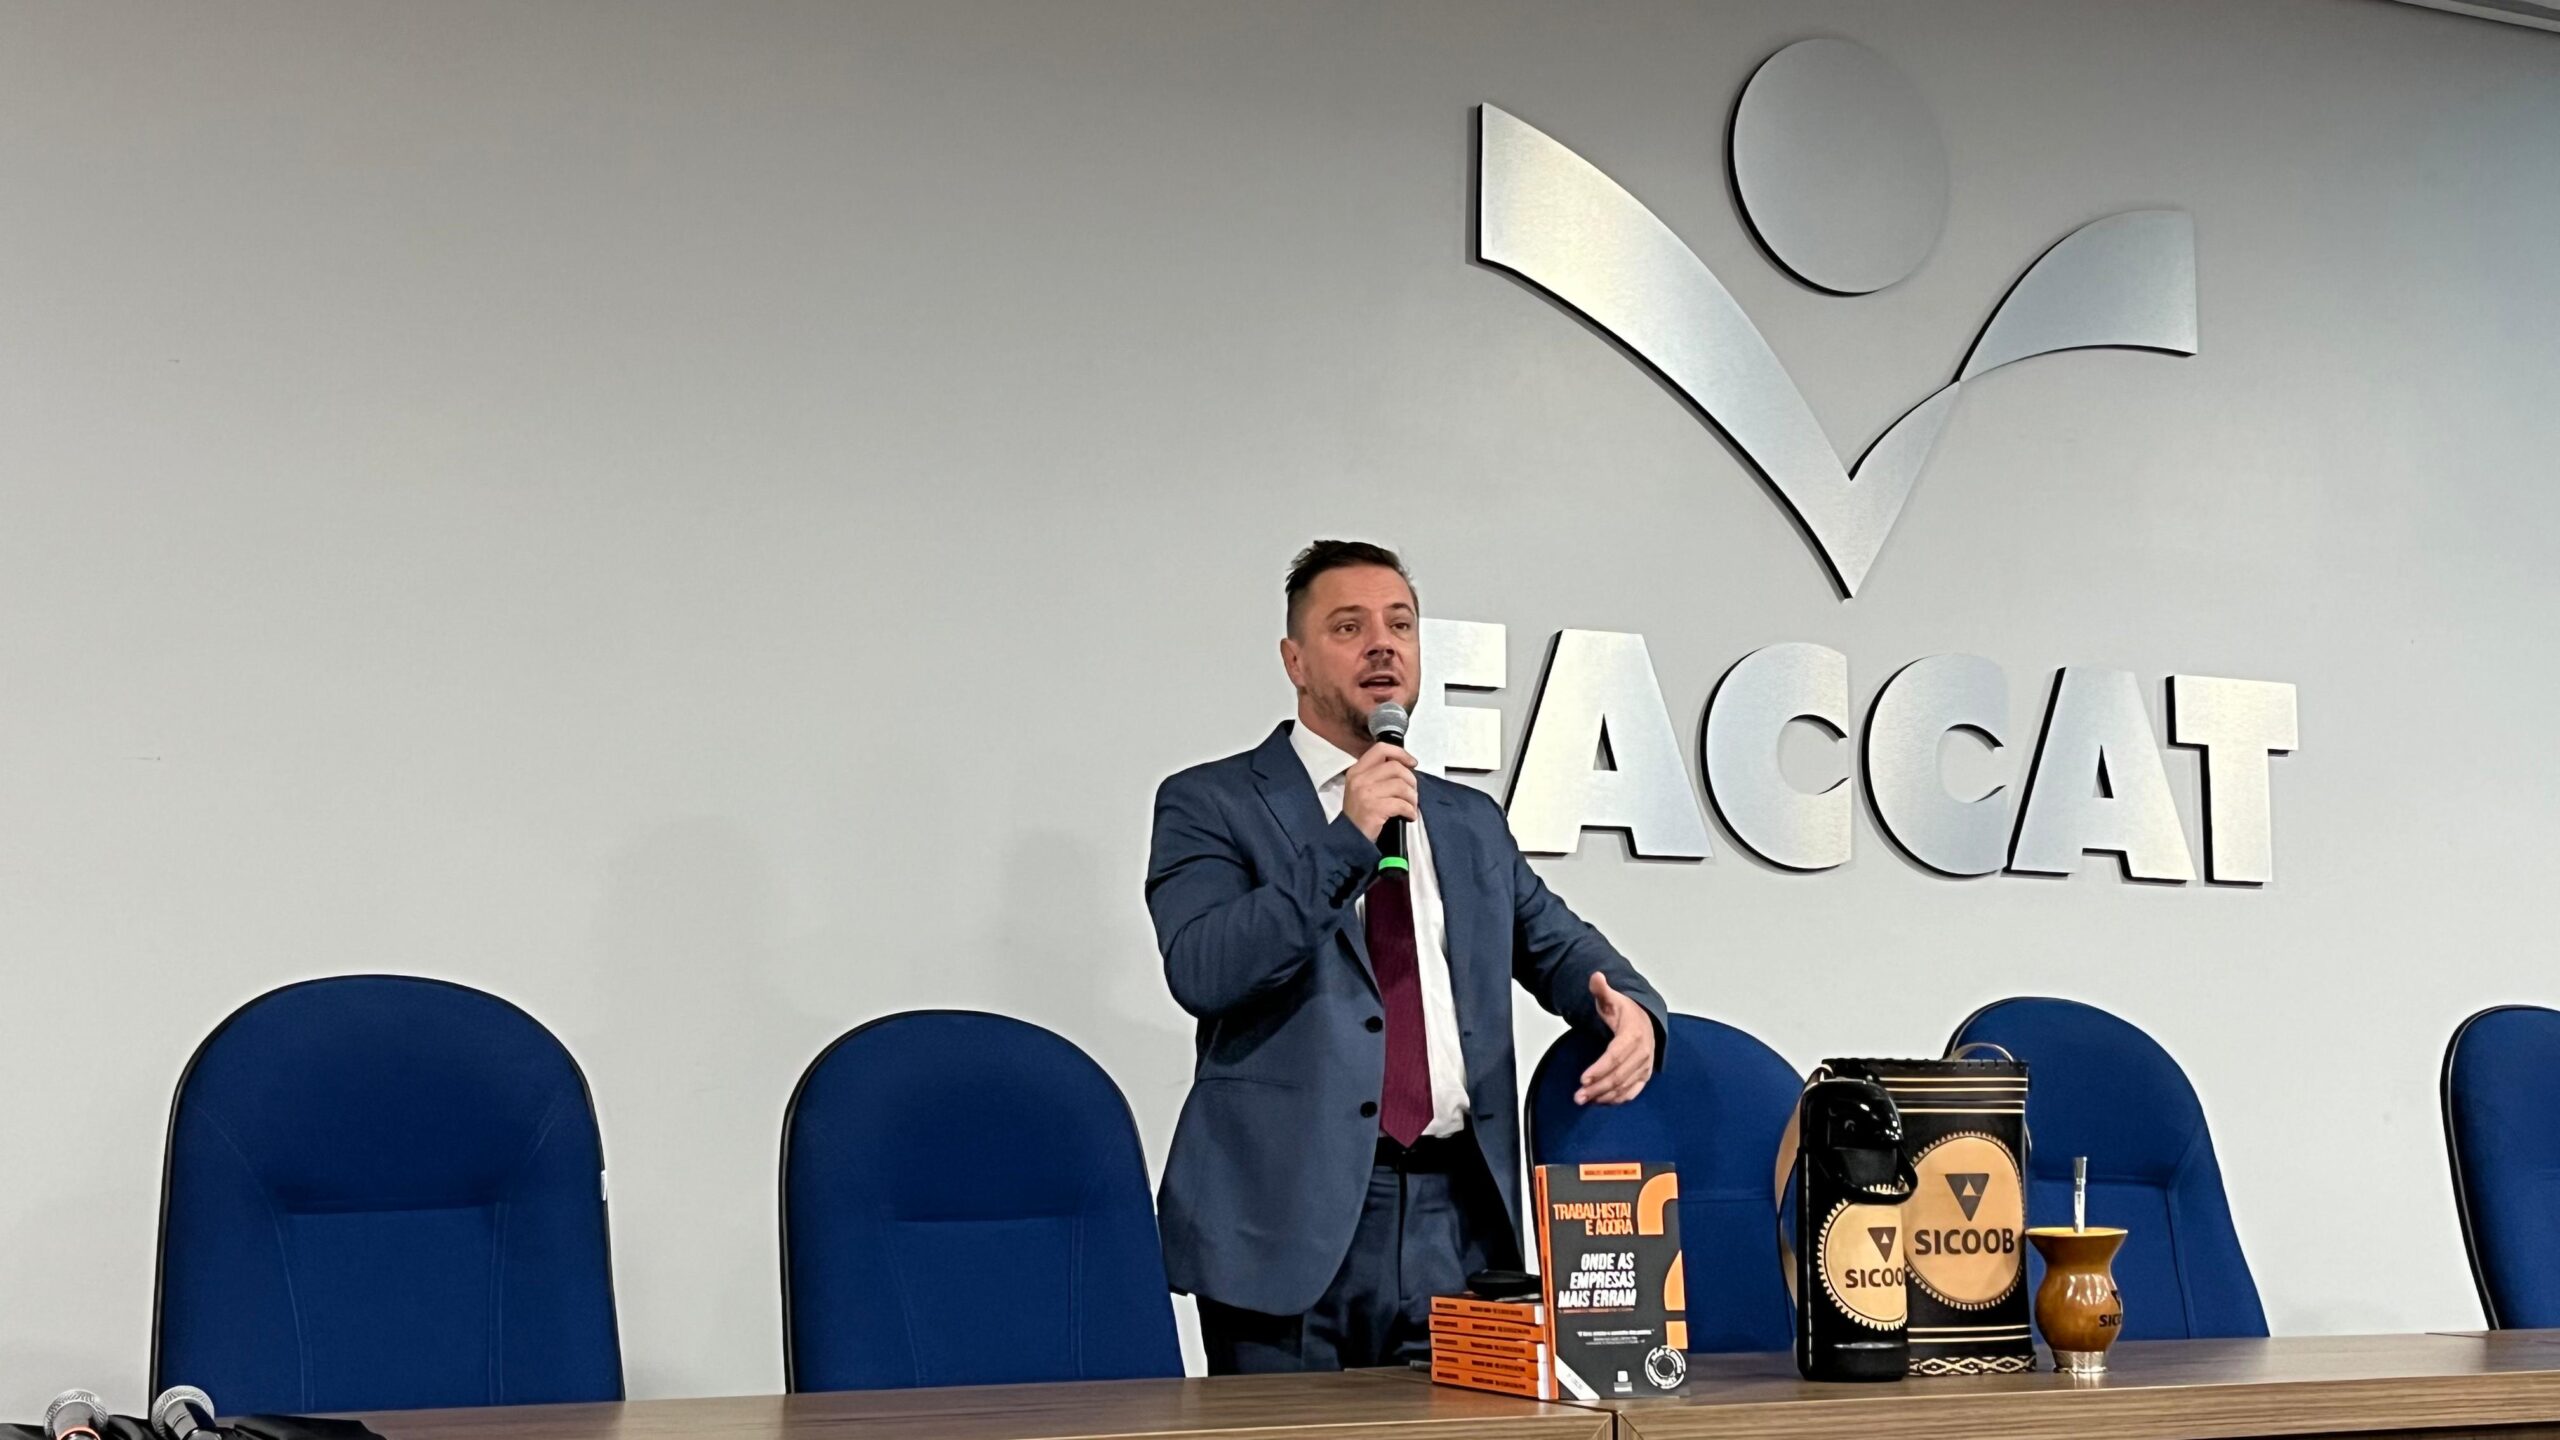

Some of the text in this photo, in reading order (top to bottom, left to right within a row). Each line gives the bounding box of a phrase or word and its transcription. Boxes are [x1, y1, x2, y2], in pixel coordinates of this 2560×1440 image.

[1404, 617, 2299, 885] FACCAT
[1585, 1219, 1594, 1236] E
[1914, 1228, 2015, 1255] SICOOB
[1580, 1252, 1635, 1271] ONDE AS
[1569, 1270, 1636, 1290] EMPRESAS
[1844, 1267, 1905, 1289] SICOO
[1557, 1289, 1637, 1309] MAIS ERRAM
